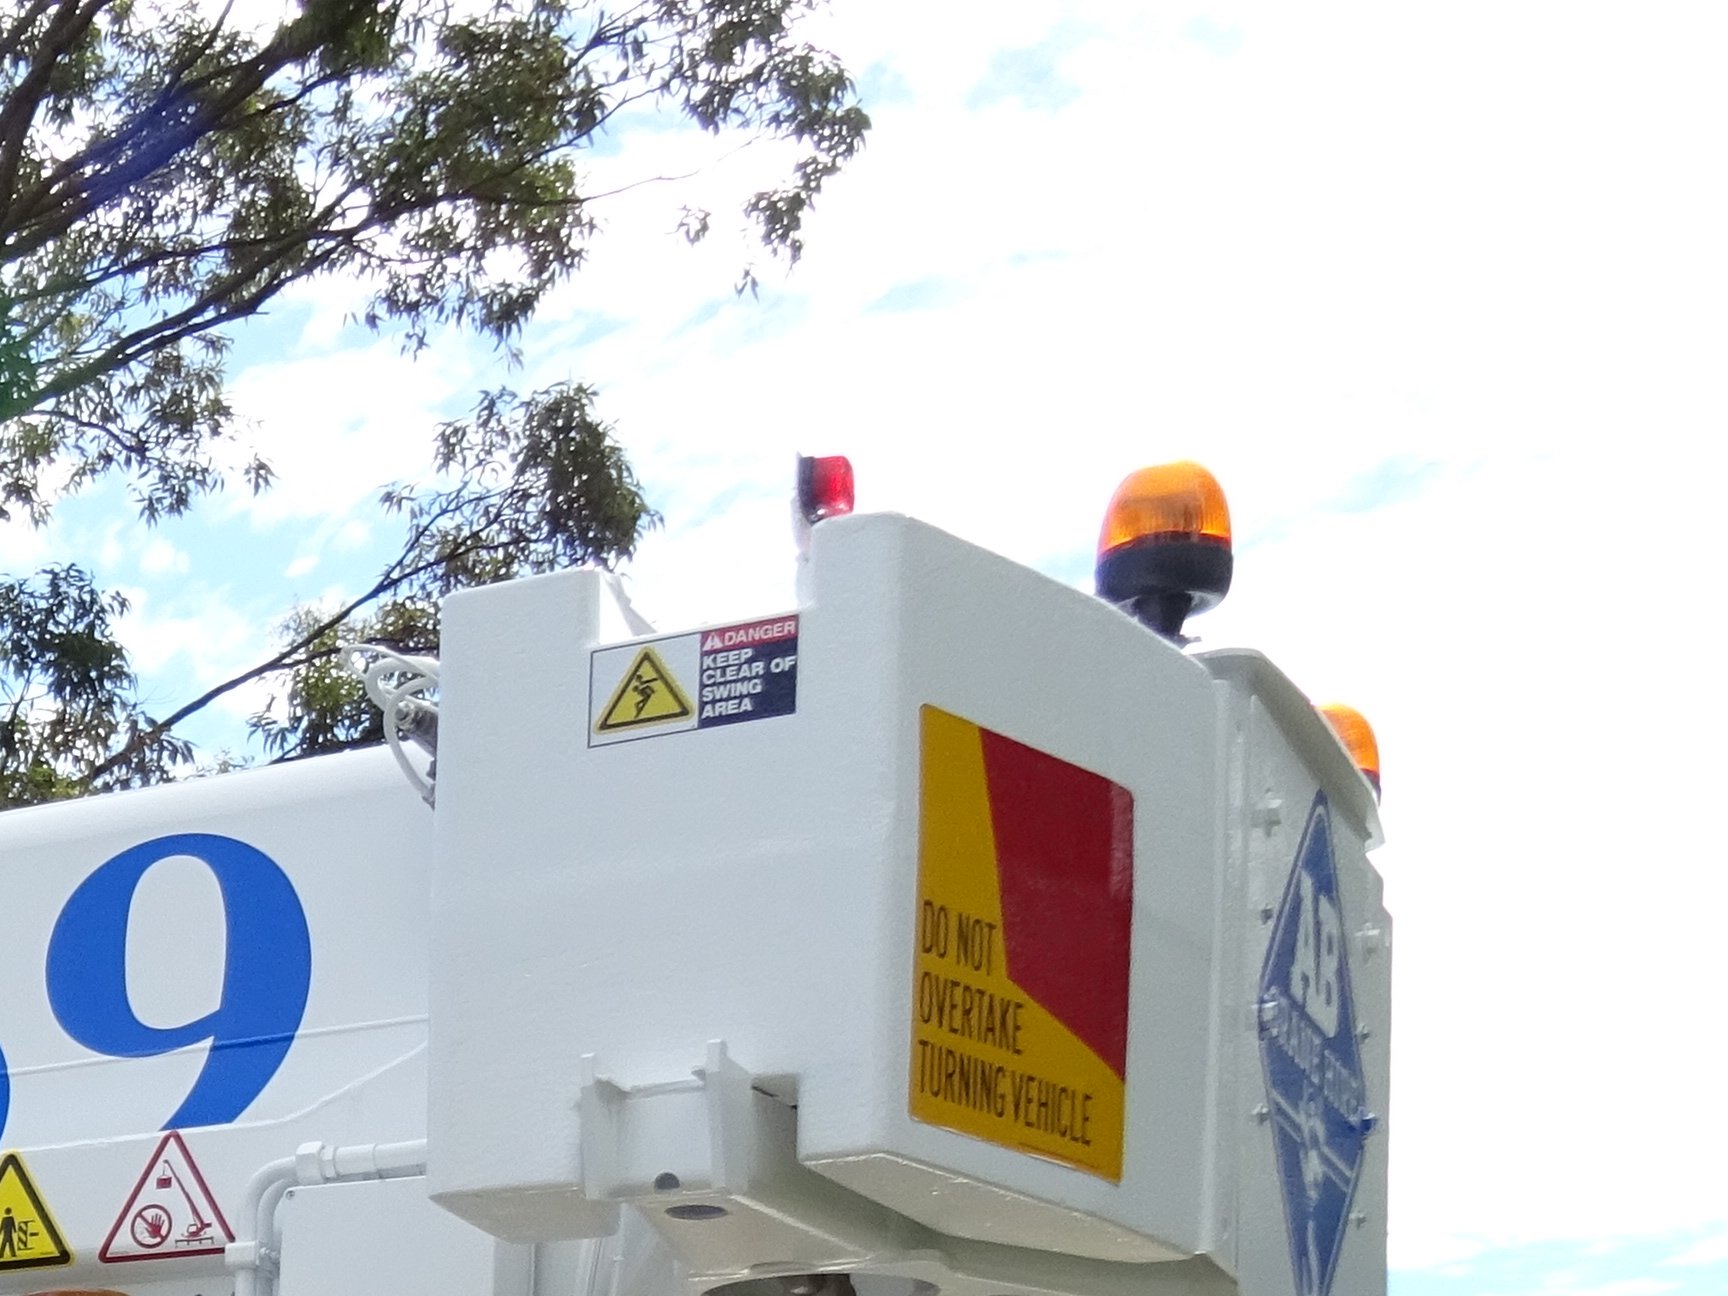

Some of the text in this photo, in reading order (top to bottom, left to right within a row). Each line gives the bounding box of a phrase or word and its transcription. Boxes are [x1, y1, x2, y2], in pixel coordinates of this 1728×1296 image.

[725, 621, 797, 646] DANGER
[702, 648, 752, 669] KEEP
[702, 656, 797, 685] CLEAR OF
[702, 679, 762, 702] SWING
[701, 698, 752, 719] AREA
[921, 899, 997, 977] DO NOT
[1289, 867, 1341, 1040] AB
[919, 971, 1025, 1056] OVERTAKE
[918, 1038, 1094, 1148] TURNING VEHICLE
